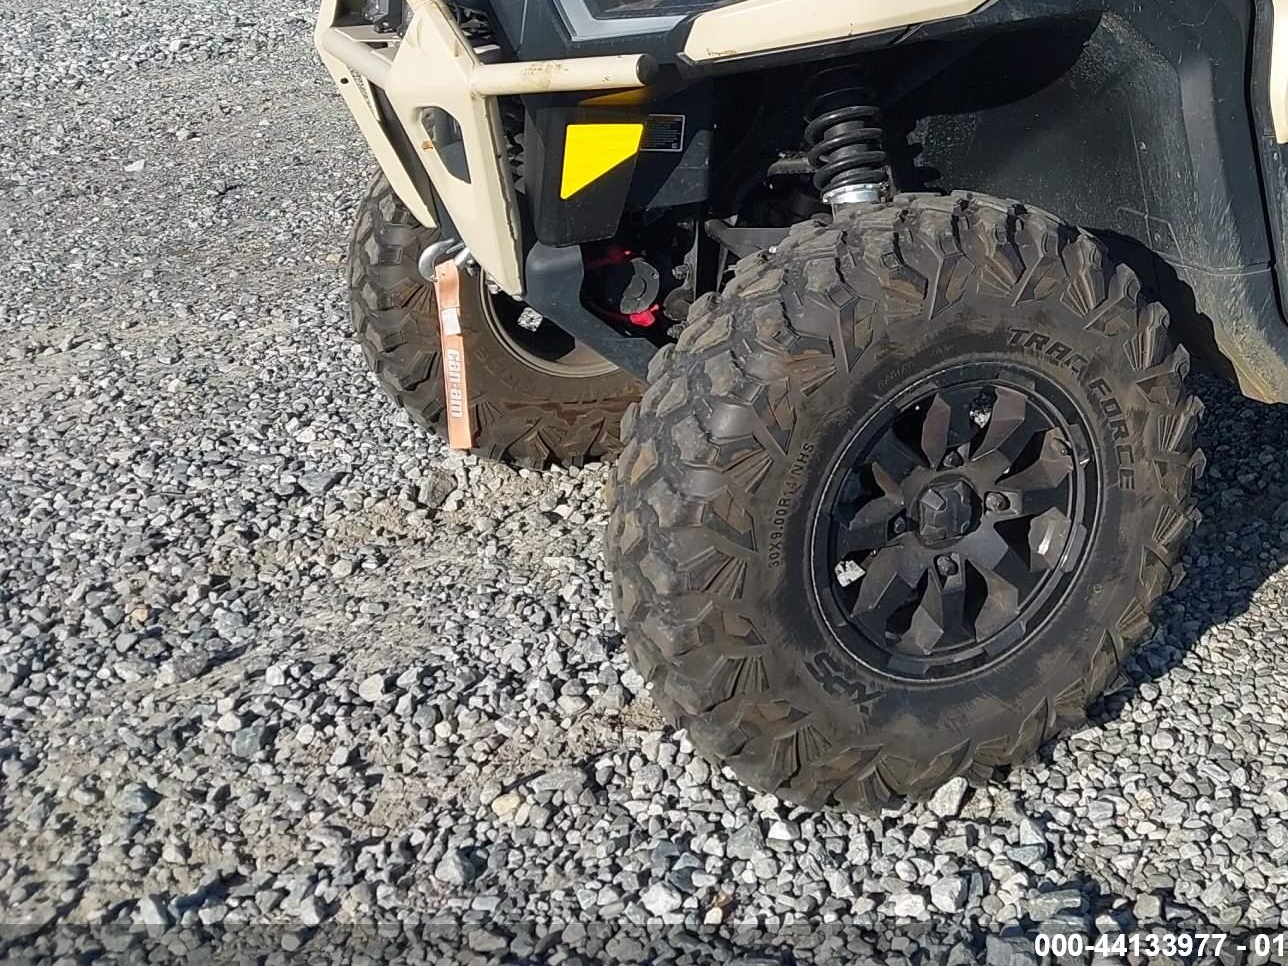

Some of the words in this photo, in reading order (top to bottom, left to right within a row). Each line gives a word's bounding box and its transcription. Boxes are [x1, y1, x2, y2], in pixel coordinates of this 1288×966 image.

[447, 348, 463, 417] can-am
[791, 442, 815, 478] NHS
[1087, 378, 1135, 490] FORCE
